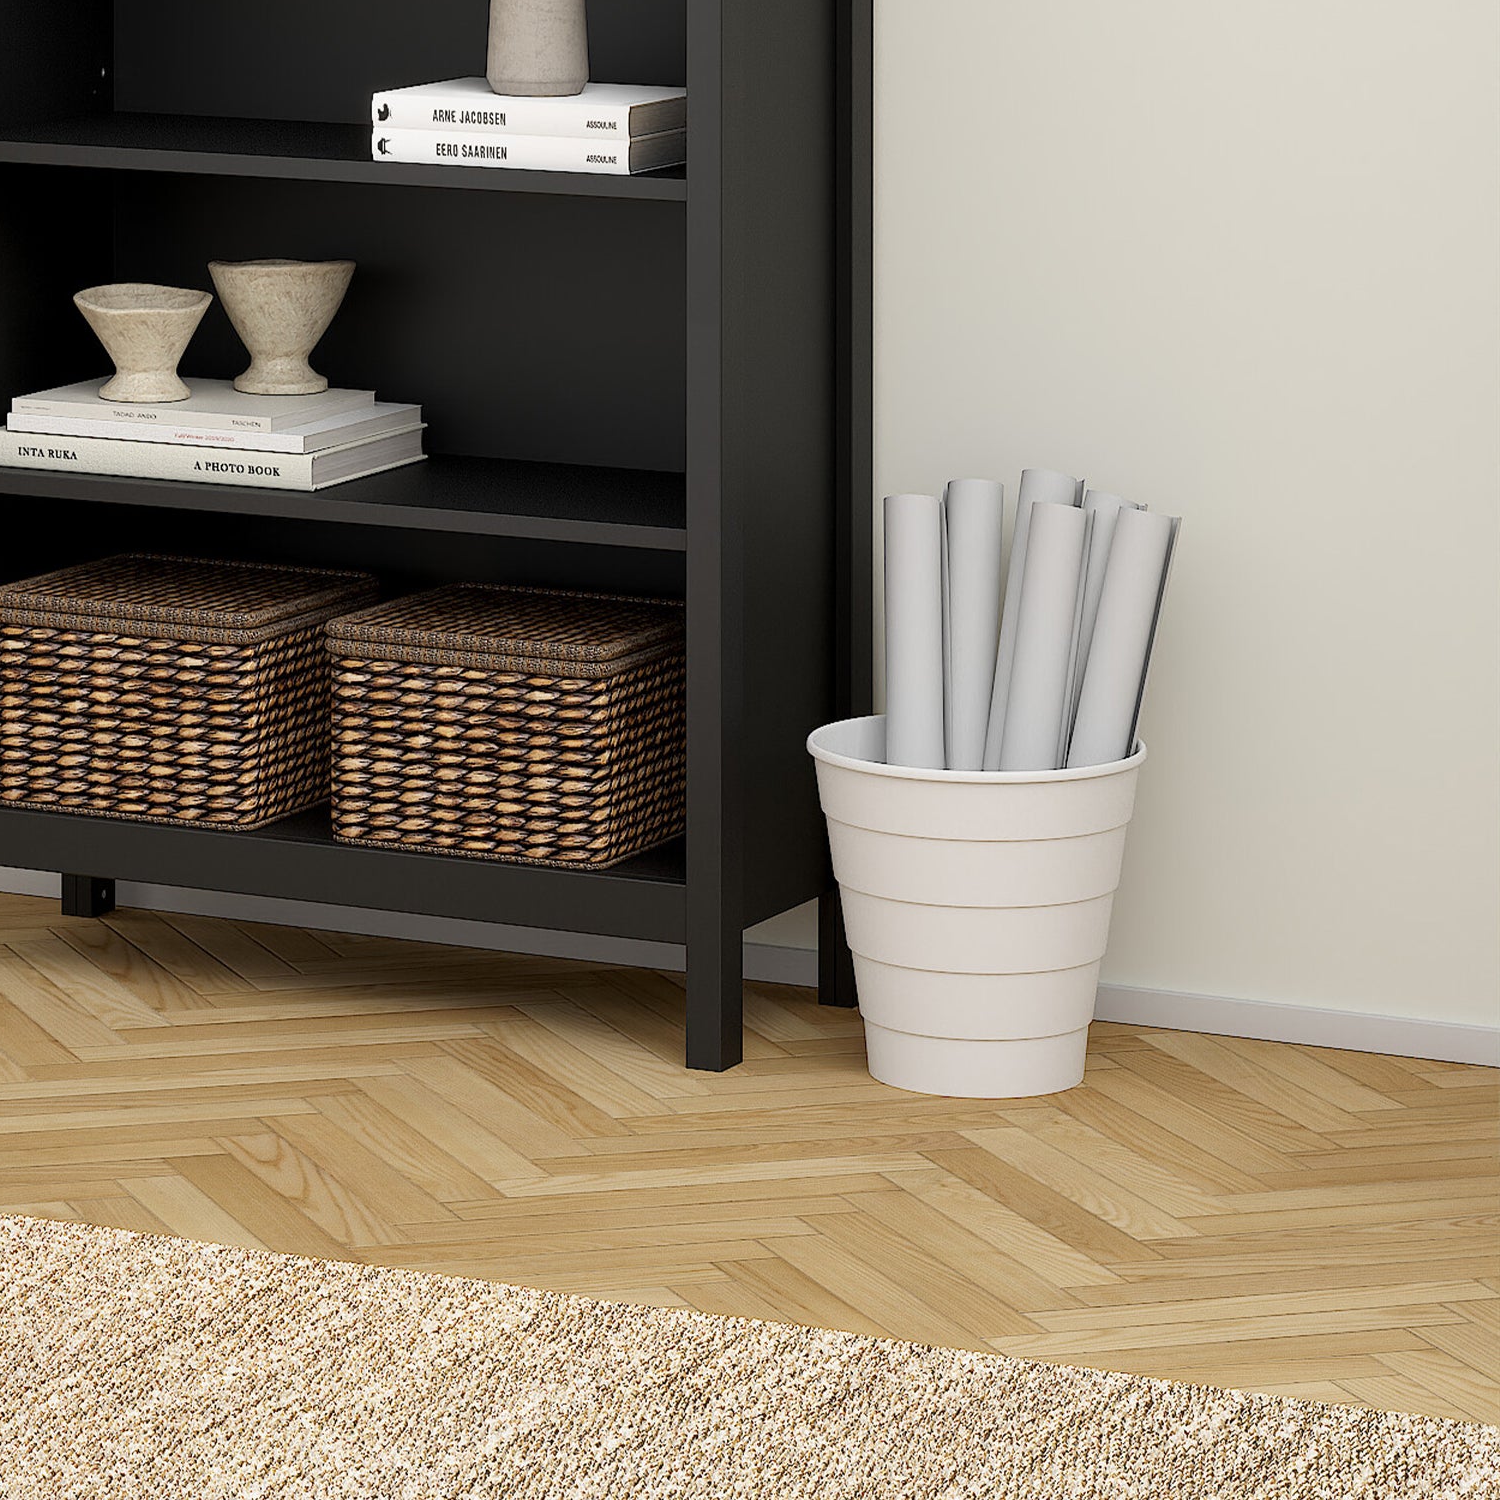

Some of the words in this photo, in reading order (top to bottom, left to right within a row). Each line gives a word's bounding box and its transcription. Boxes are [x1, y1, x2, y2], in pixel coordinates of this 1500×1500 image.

[432, 109, 457, 123] ARNE
[459, 110, 506, 126] JACOBSEN
[586, 119, 617, 130] ASSOULINE
[436, 142, 459, 157] EERO
[461, 144, 508, 160] SAARINEN
[586, 154, 617, 165] ASSOULINE
[231, 419, 262, 429] TASCHEN
[17, 446, 45, 459] INTA
[47, 447, 78, 460] RUKA
[193, 461, 202, 470] A
[204, 462, 244, 475] PHOTO
[247, 465, 281, 477] BOOK
